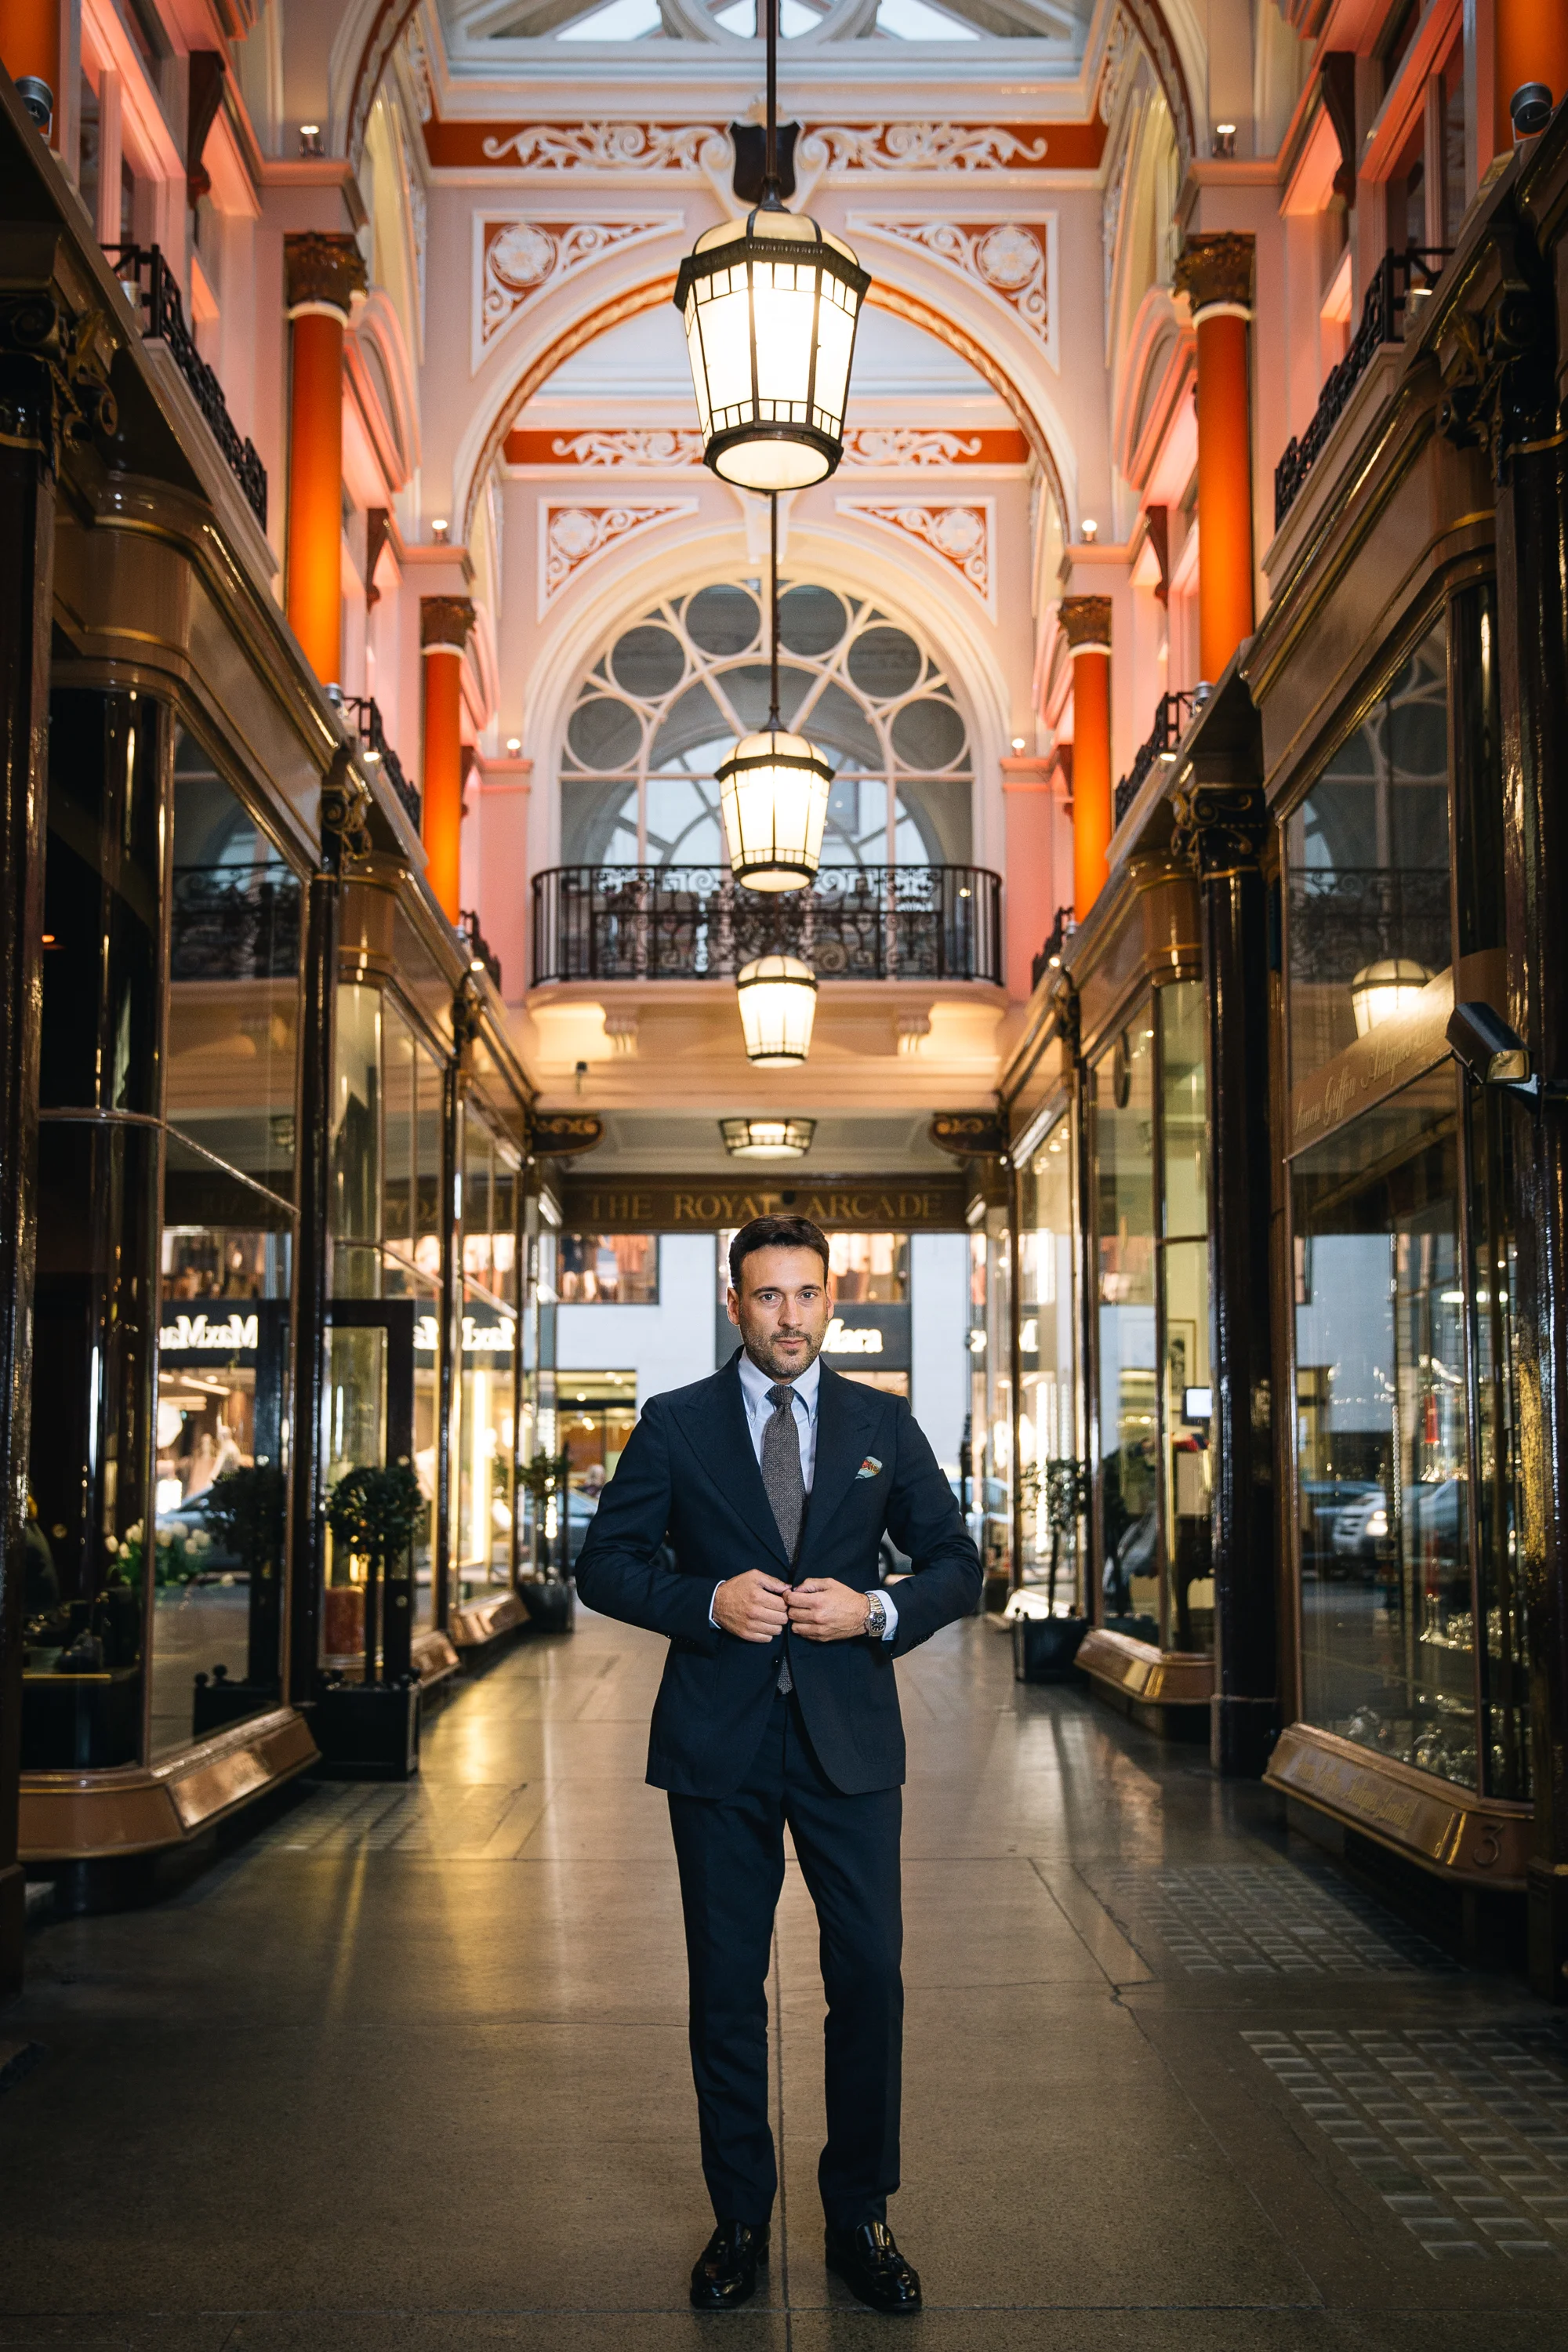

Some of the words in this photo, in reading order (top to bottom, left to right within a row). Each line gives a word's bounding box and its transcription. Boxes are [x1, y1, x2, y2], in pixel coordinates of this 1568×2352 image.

[591, 1194, 651, 1220] THE
[804, 1194, 941, 1219] ARCADE
[1473, 1820, 1504, 1865] 3
